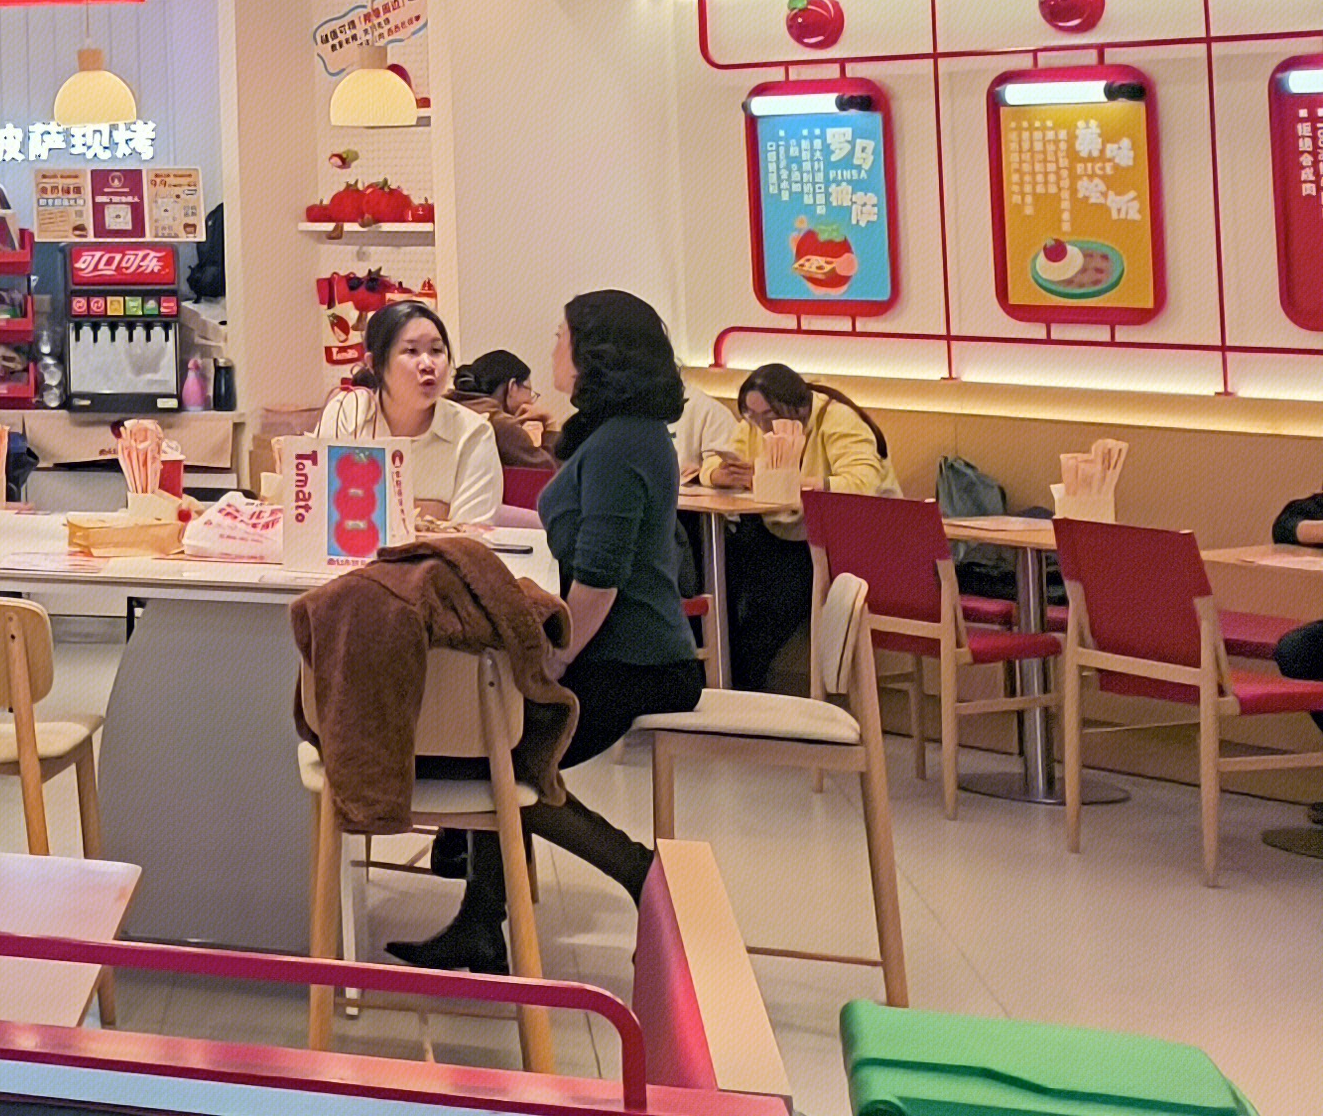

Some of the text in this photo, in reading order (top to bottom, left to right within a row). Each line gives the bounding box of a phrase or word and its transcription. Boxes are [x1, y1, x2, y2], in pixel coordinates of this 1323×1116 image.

[74, 249, 166, 278] 可口可乐
[295, 450, 318, 524] Tomato
